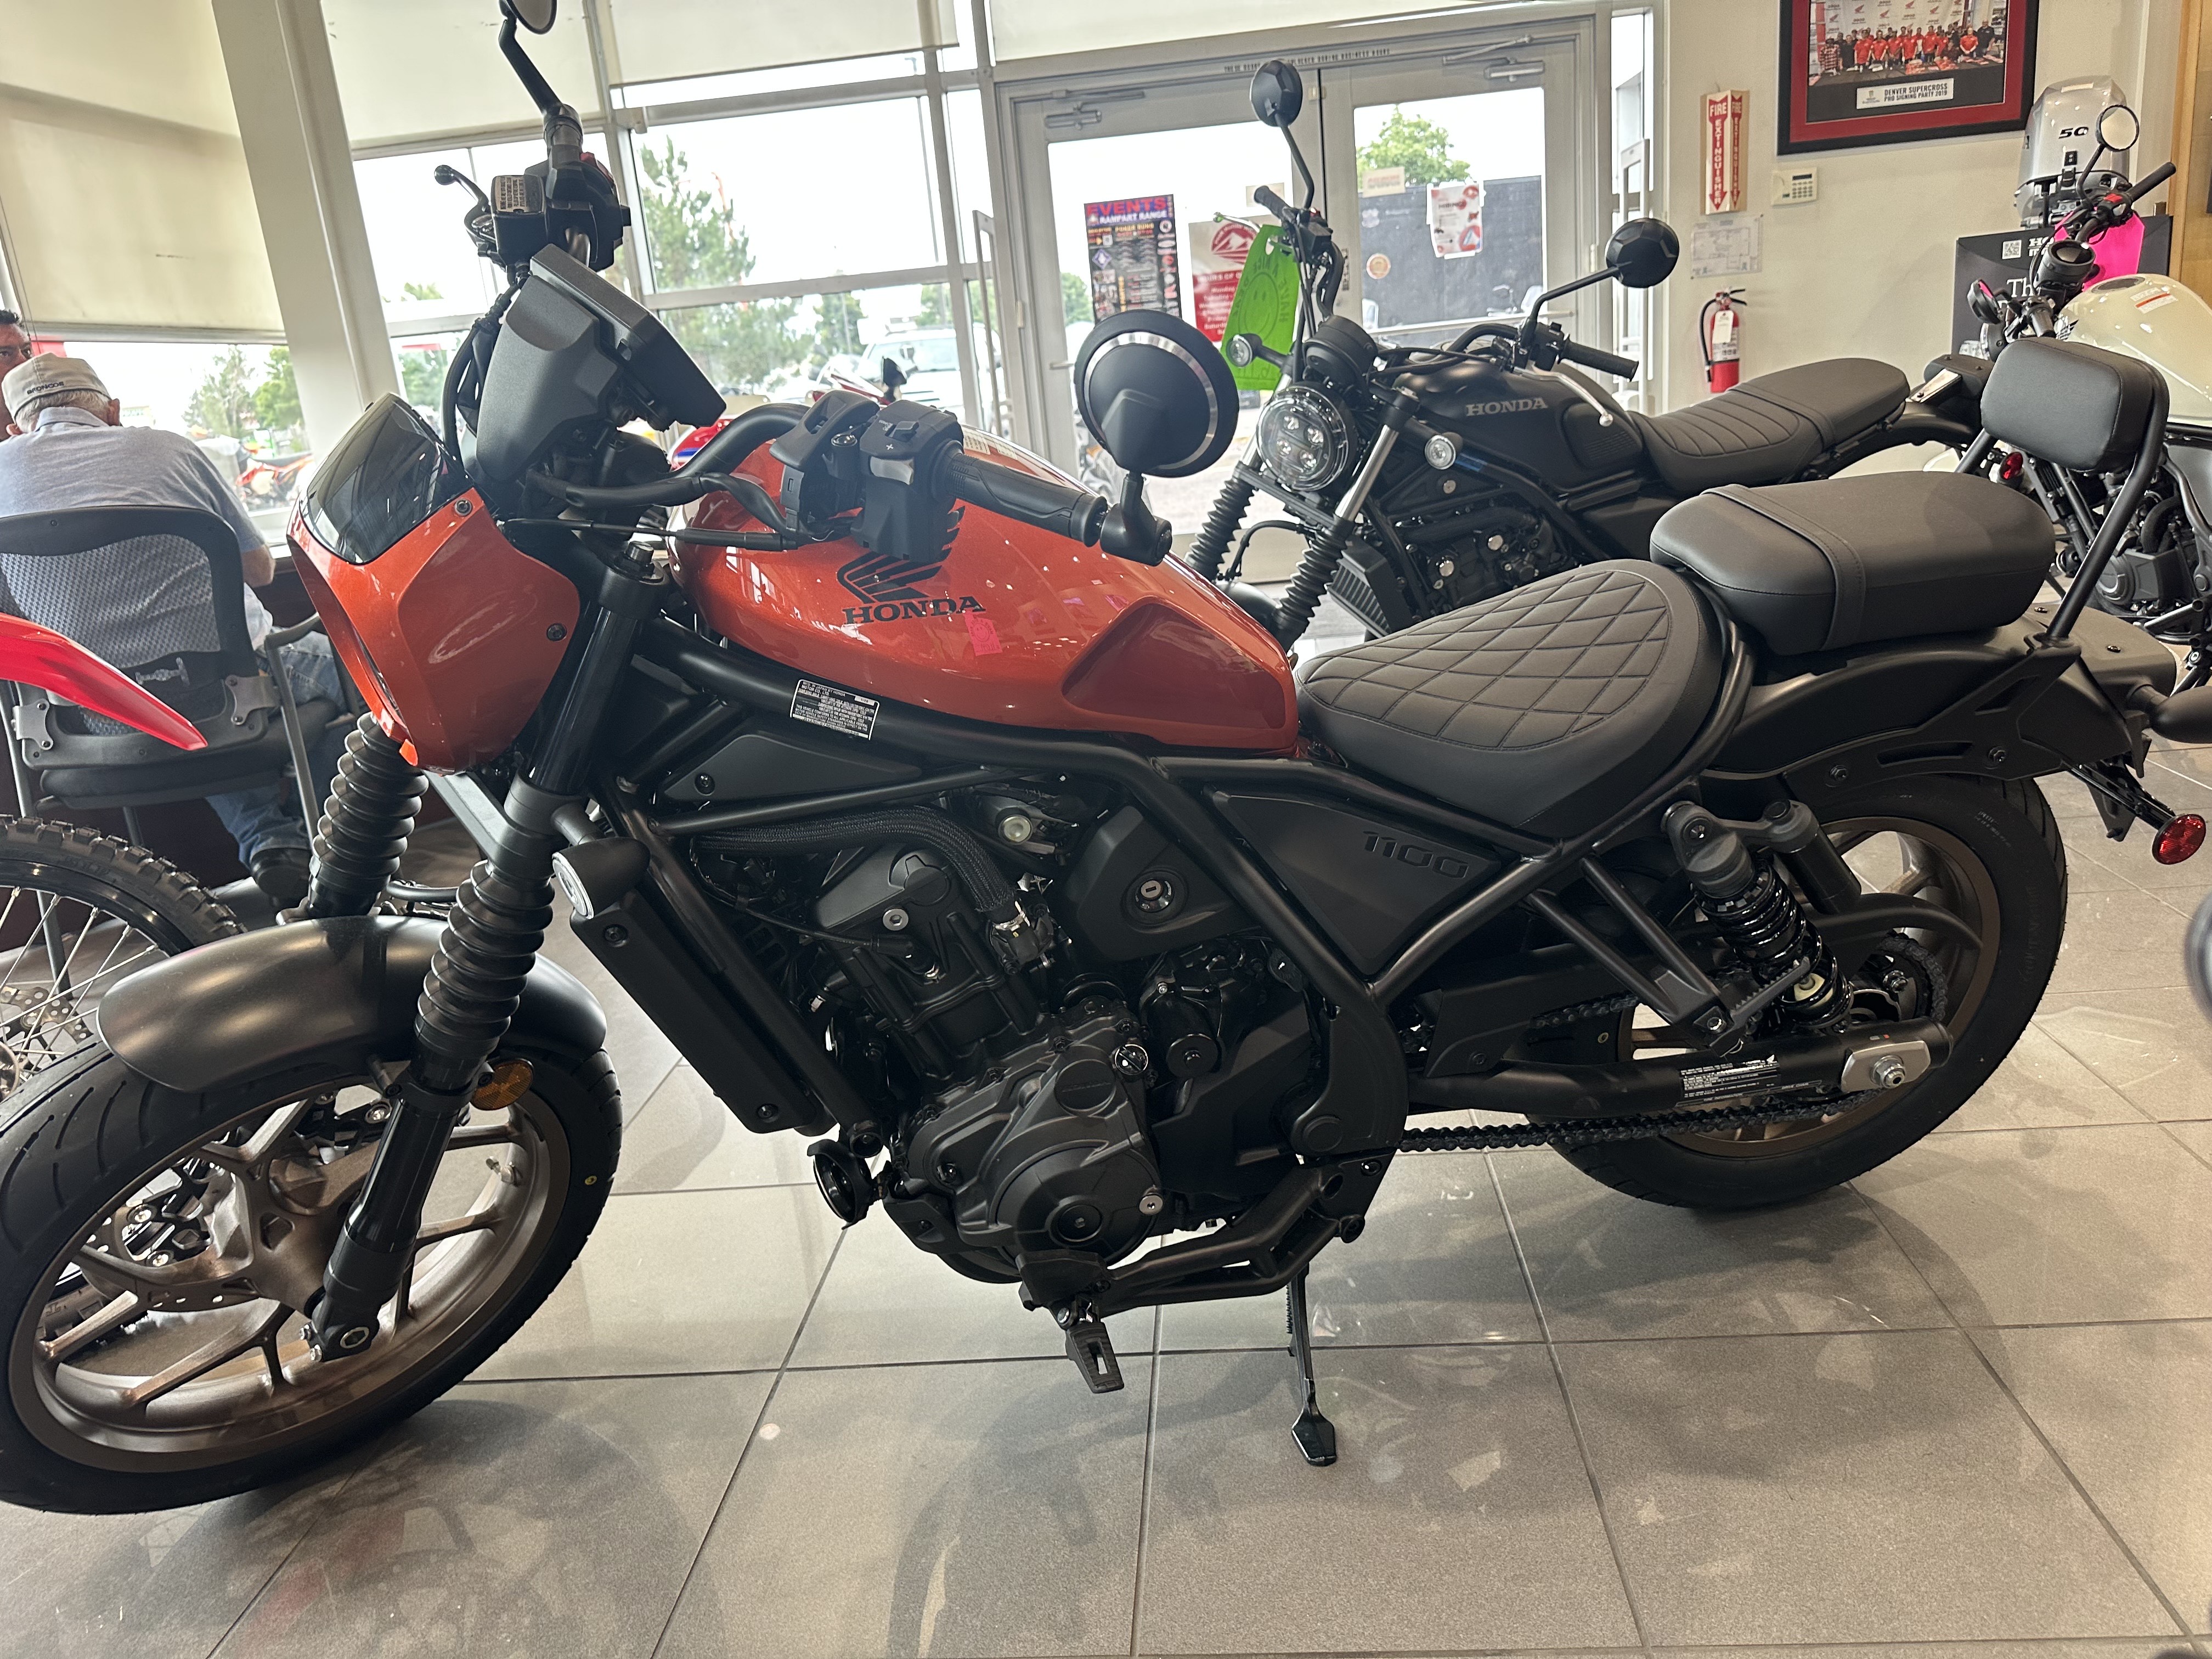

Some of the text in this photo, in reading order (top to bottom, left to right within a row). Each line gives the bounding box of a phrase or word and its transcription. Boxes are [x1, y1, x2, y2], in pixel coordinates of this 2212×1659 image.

[1884, 83, 1948, 96] DENVER SUPERCROSS
[1710, 103, 1727, 116] FIRE
[1087, 197, 1166, 216] EVENTS
[1466, 397, 1548, 416] HONDA
[843, 596, 985, 624] HONDA
[1363, 831, 1469, 878] 1100
